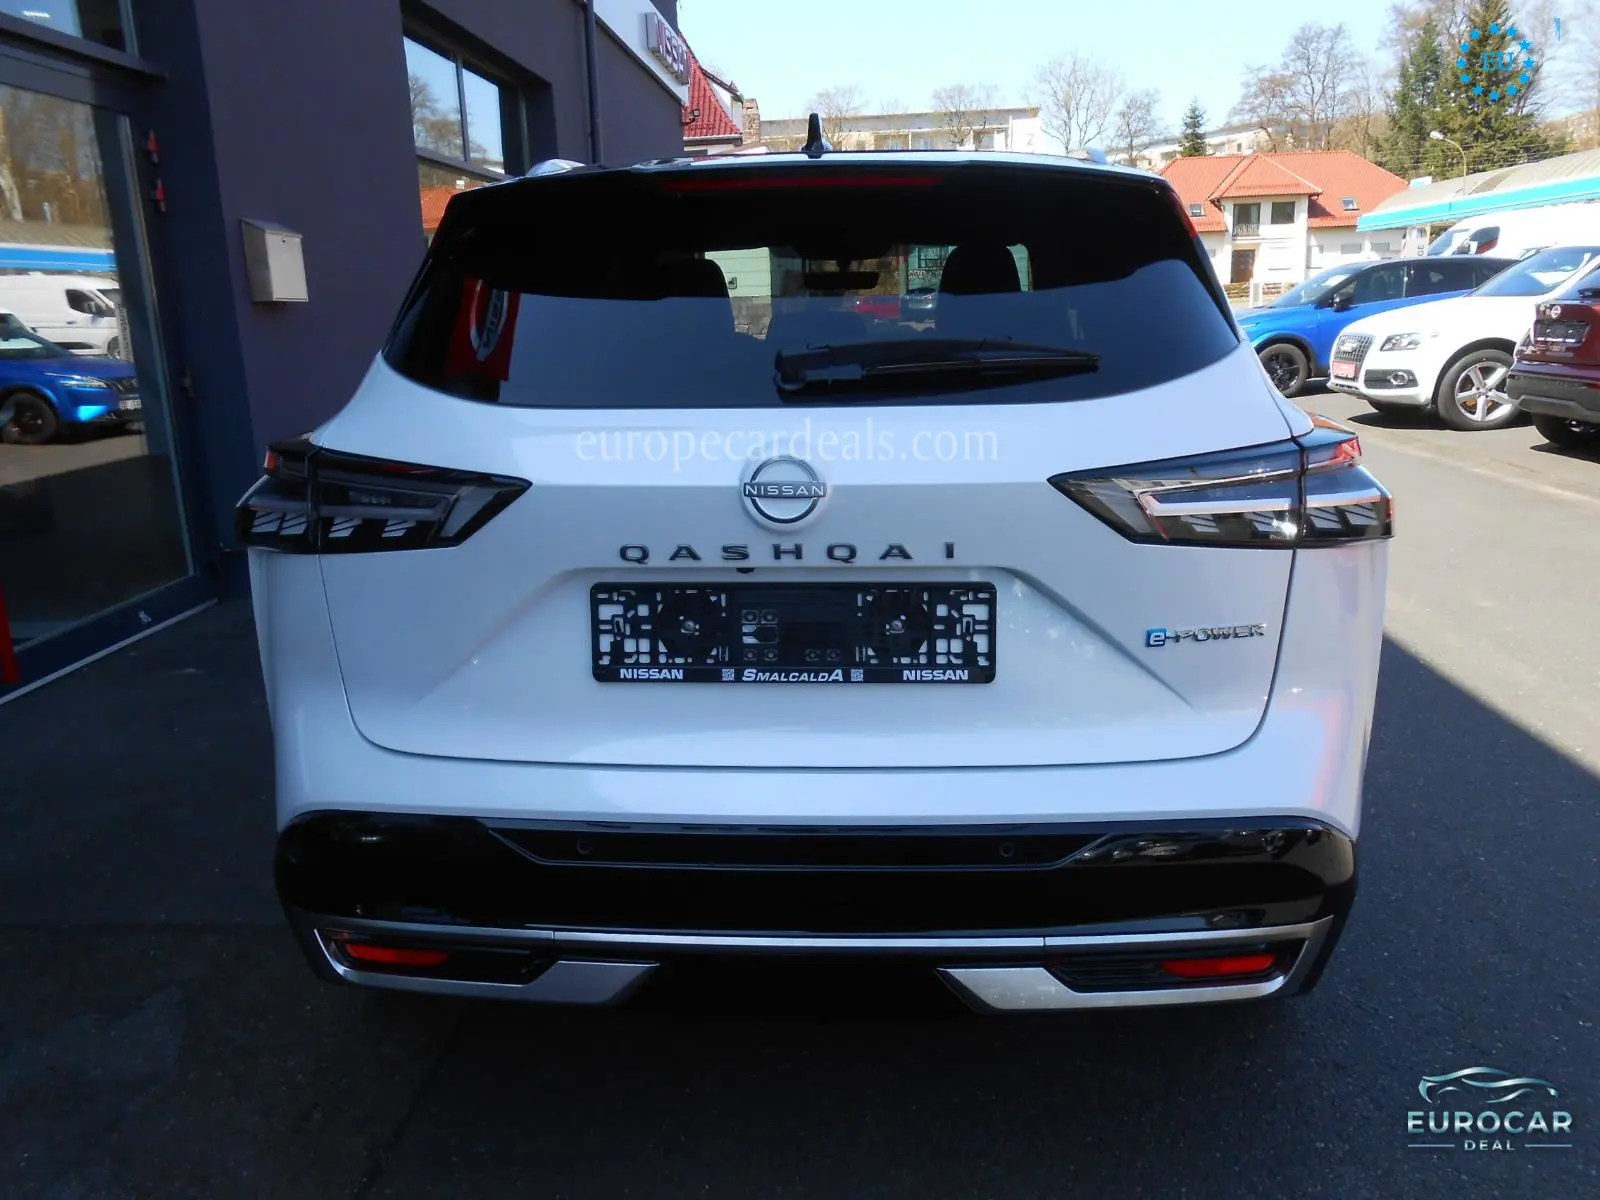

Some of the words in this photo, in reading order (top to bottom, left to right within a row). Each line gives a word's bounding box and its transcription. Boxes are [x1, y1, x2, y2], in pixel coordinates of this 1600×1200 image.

[745, 483, 826, 497] NISSAN
[619, 542, 956, 564] QASHQAI
[620, 668, 684, 680] NISSAN
[902, 669, 969, 681] NISSAN
